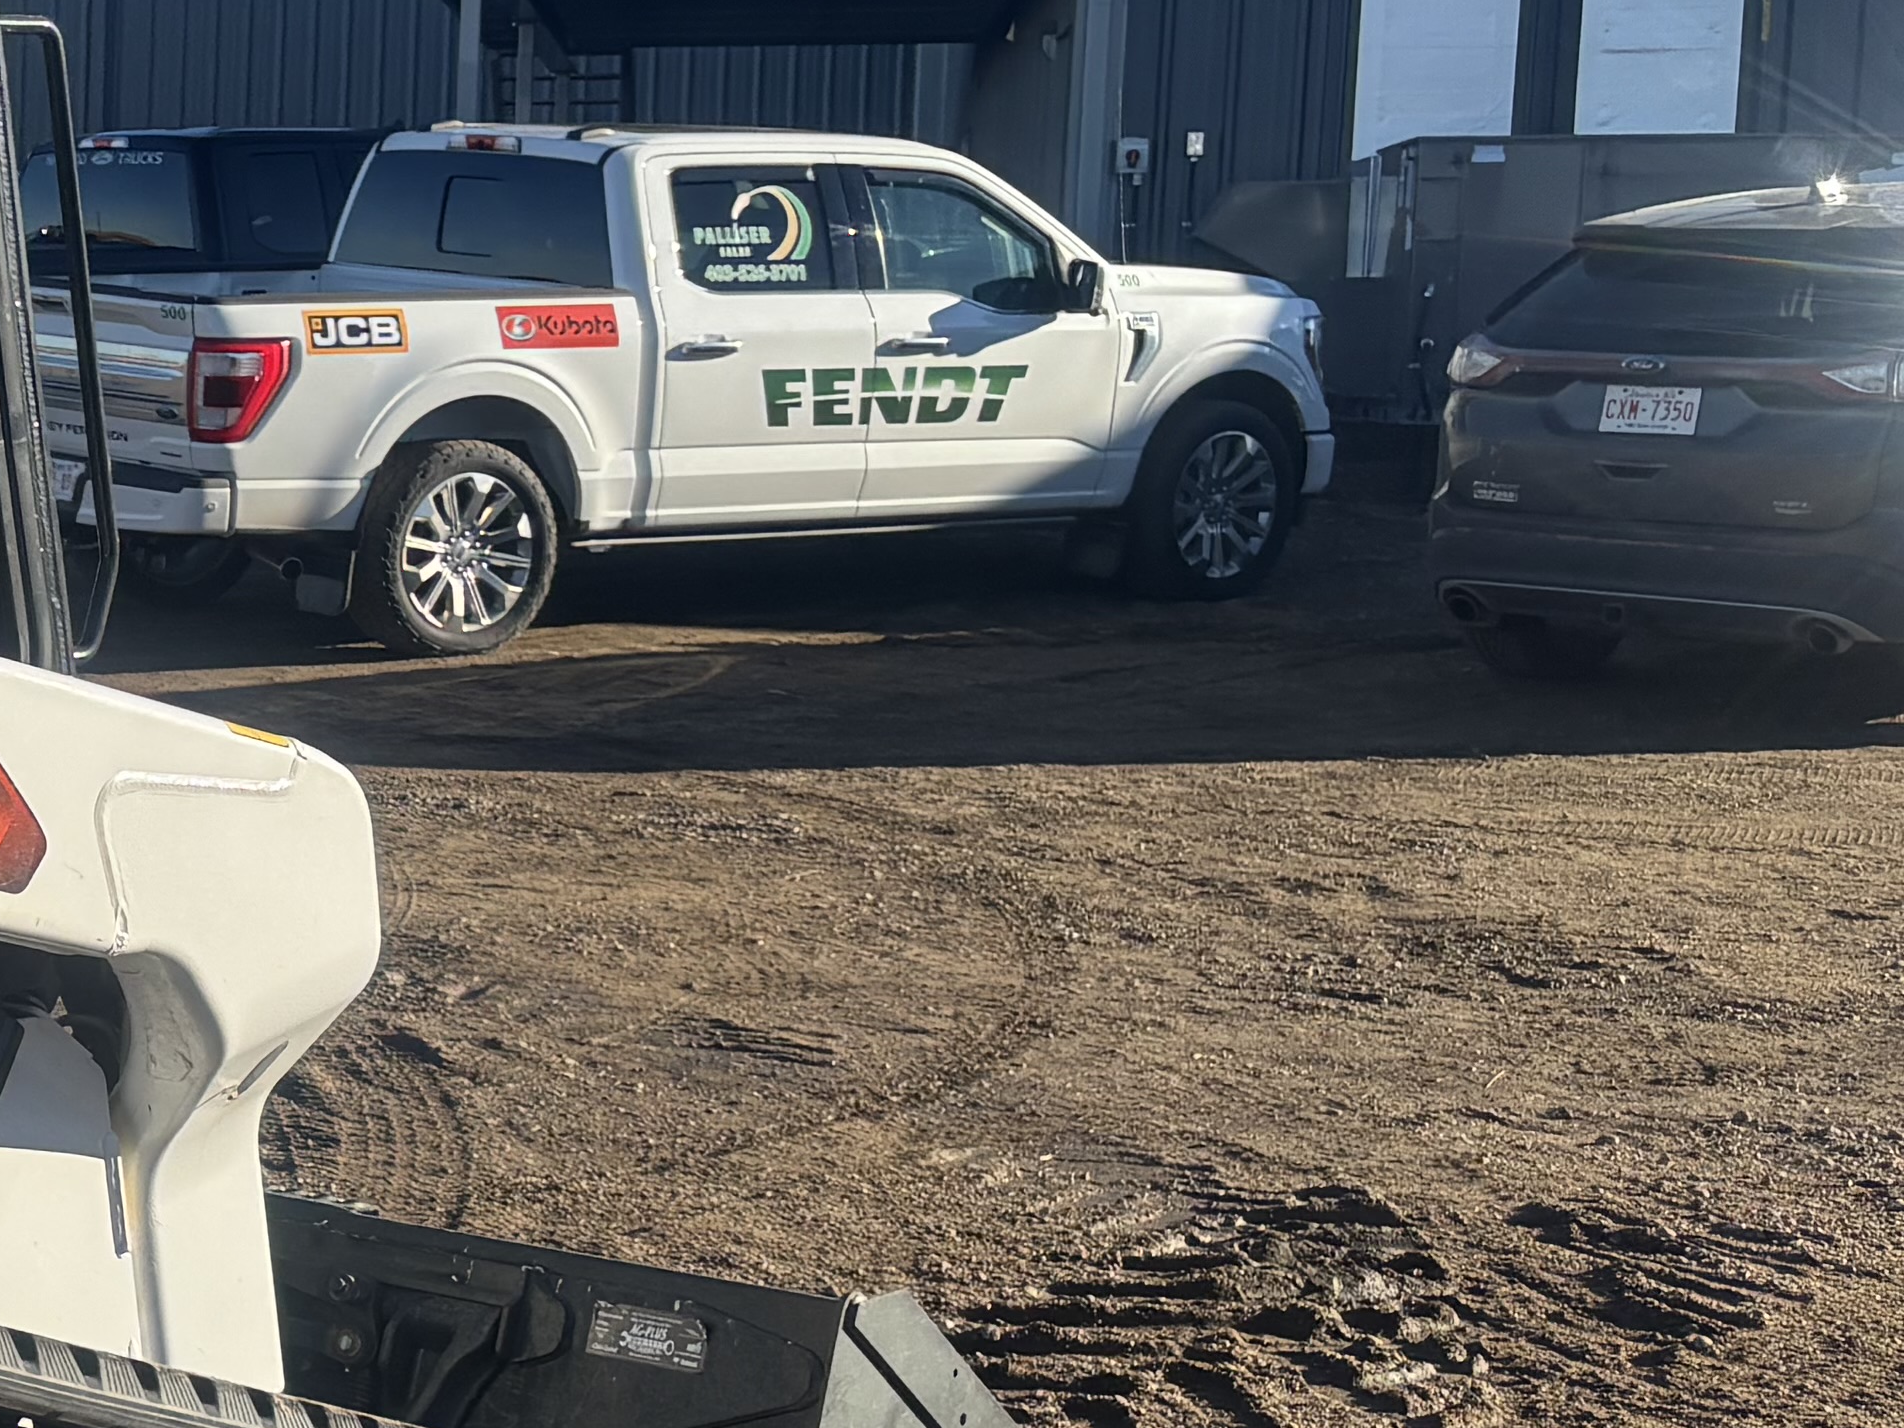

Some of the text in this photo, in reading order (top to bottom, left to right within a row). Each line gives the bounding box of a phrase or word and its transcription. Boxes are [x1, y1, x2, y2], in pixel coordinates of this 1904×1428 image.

[118, 152, 163, 165] TRUCKS
[693, 223, 772, 245] PALLISER
[1117, 274, 1140, 287] 500
[160, 306, 186, 321] 500
[313, 316, 402, 347] JCB
[538, 314, 617, 336] Kubota
[762, 365, 1029, 427] FENDT
